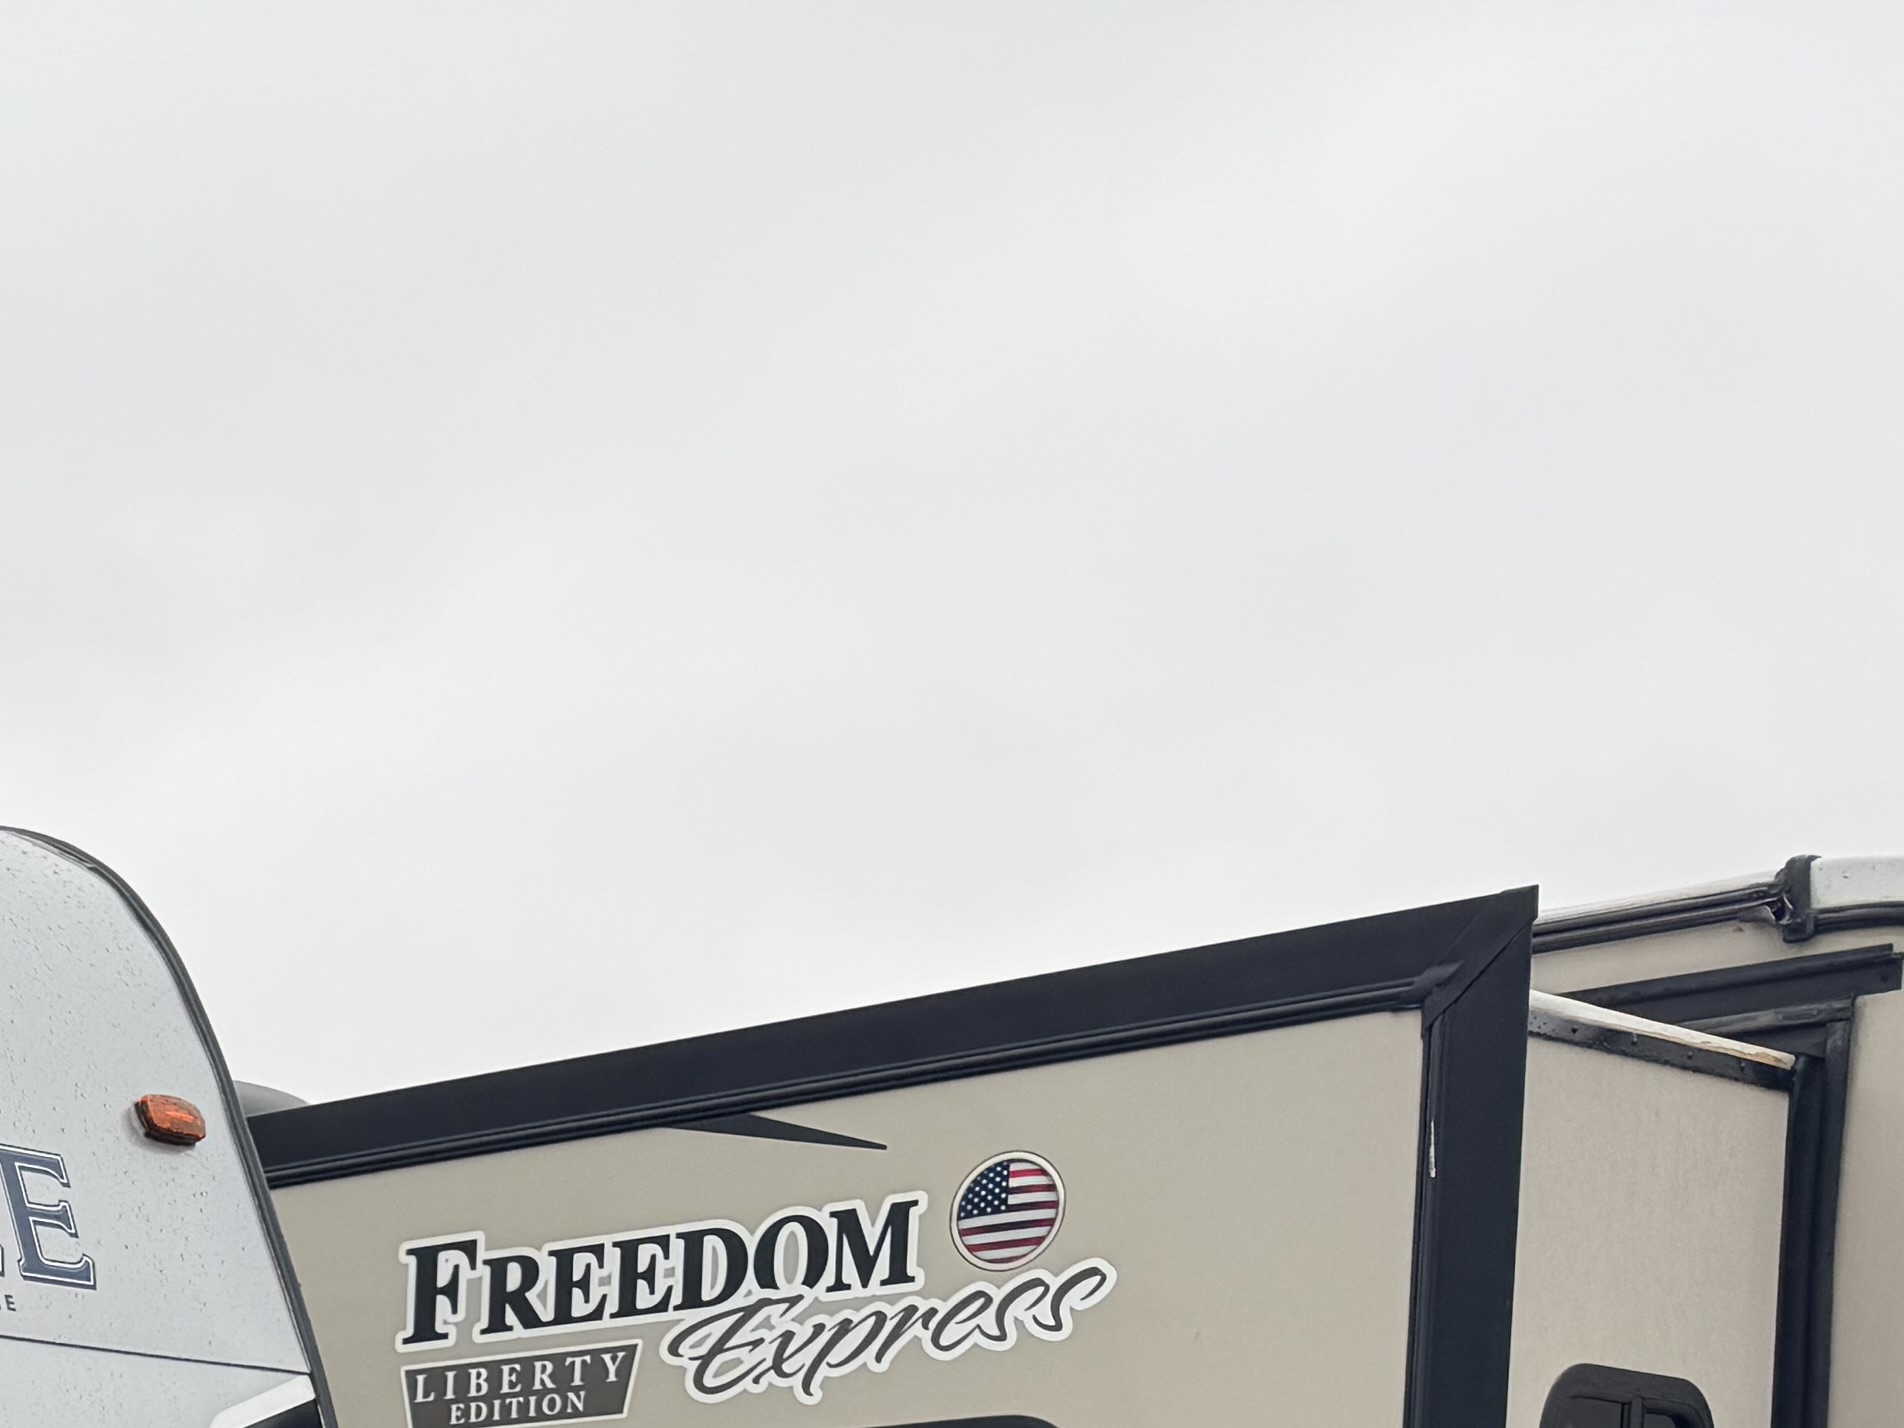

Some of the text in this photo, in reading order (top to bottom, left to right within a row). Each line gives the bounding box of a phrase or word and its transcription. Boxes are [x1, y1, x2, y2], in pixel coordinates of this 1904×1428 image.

[401, 1198, 920, 1346] FREEDOM
[667, 1264, 1107, 1397] Express
[413, 1352, 629, 1404] LIBERTY
[449, 1390, 588, 1426] EDITION
